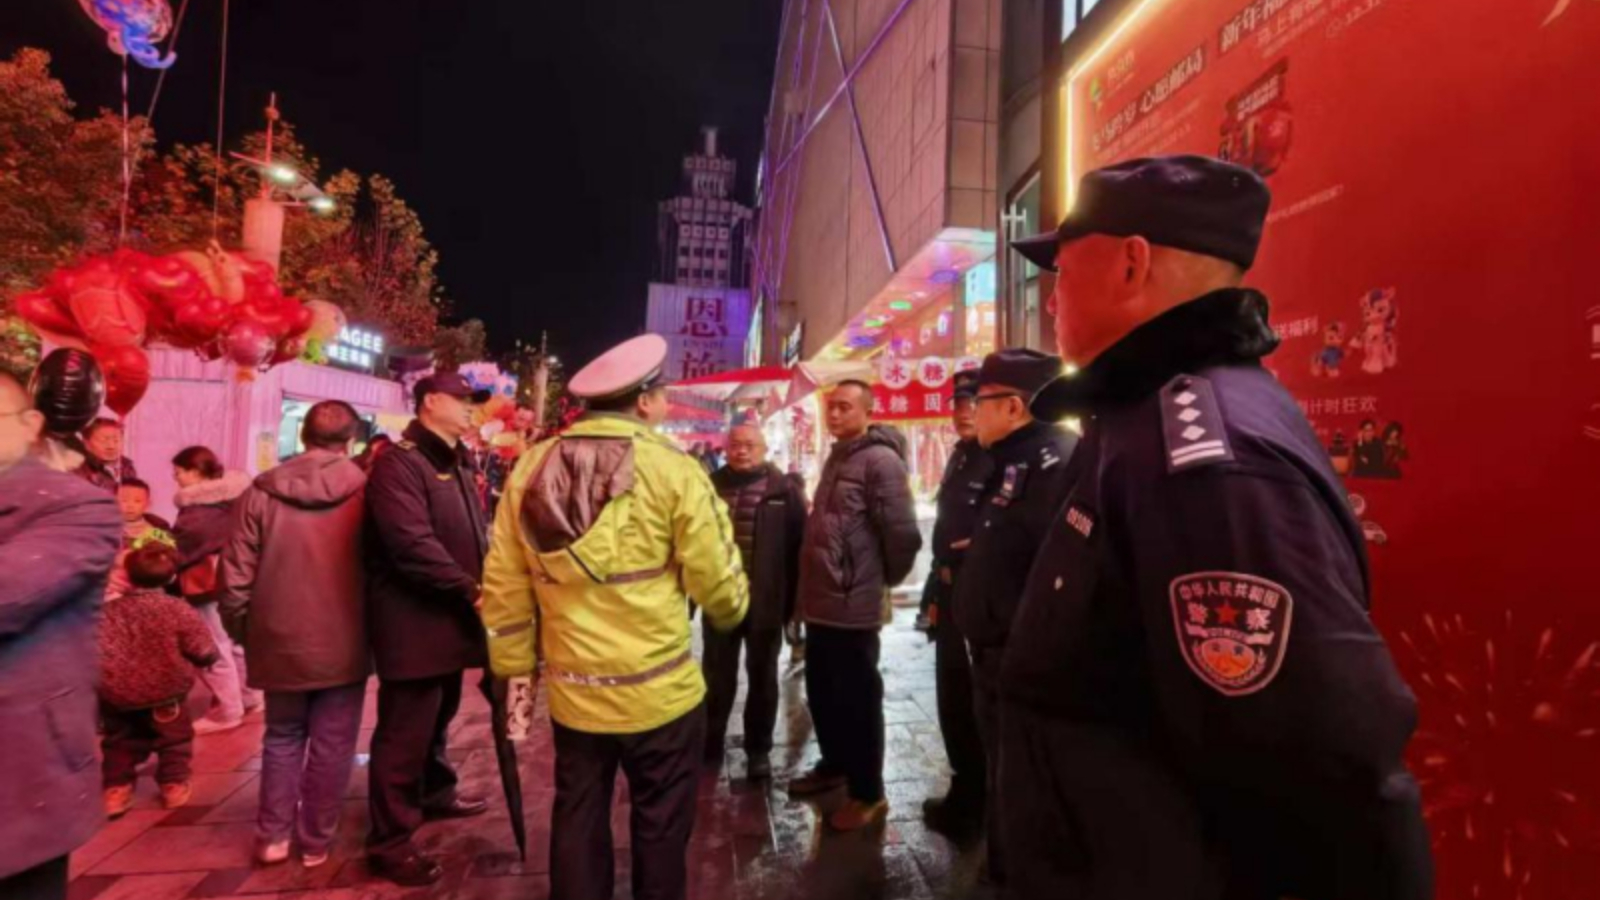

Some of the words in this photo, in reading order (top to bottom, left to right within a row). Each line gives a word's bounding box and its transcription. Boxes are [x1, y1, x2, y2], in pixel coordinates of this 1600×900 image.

[680, 296, 728, 337] 恩
[1179, 581, 1280, 609] 中华人民共和国
